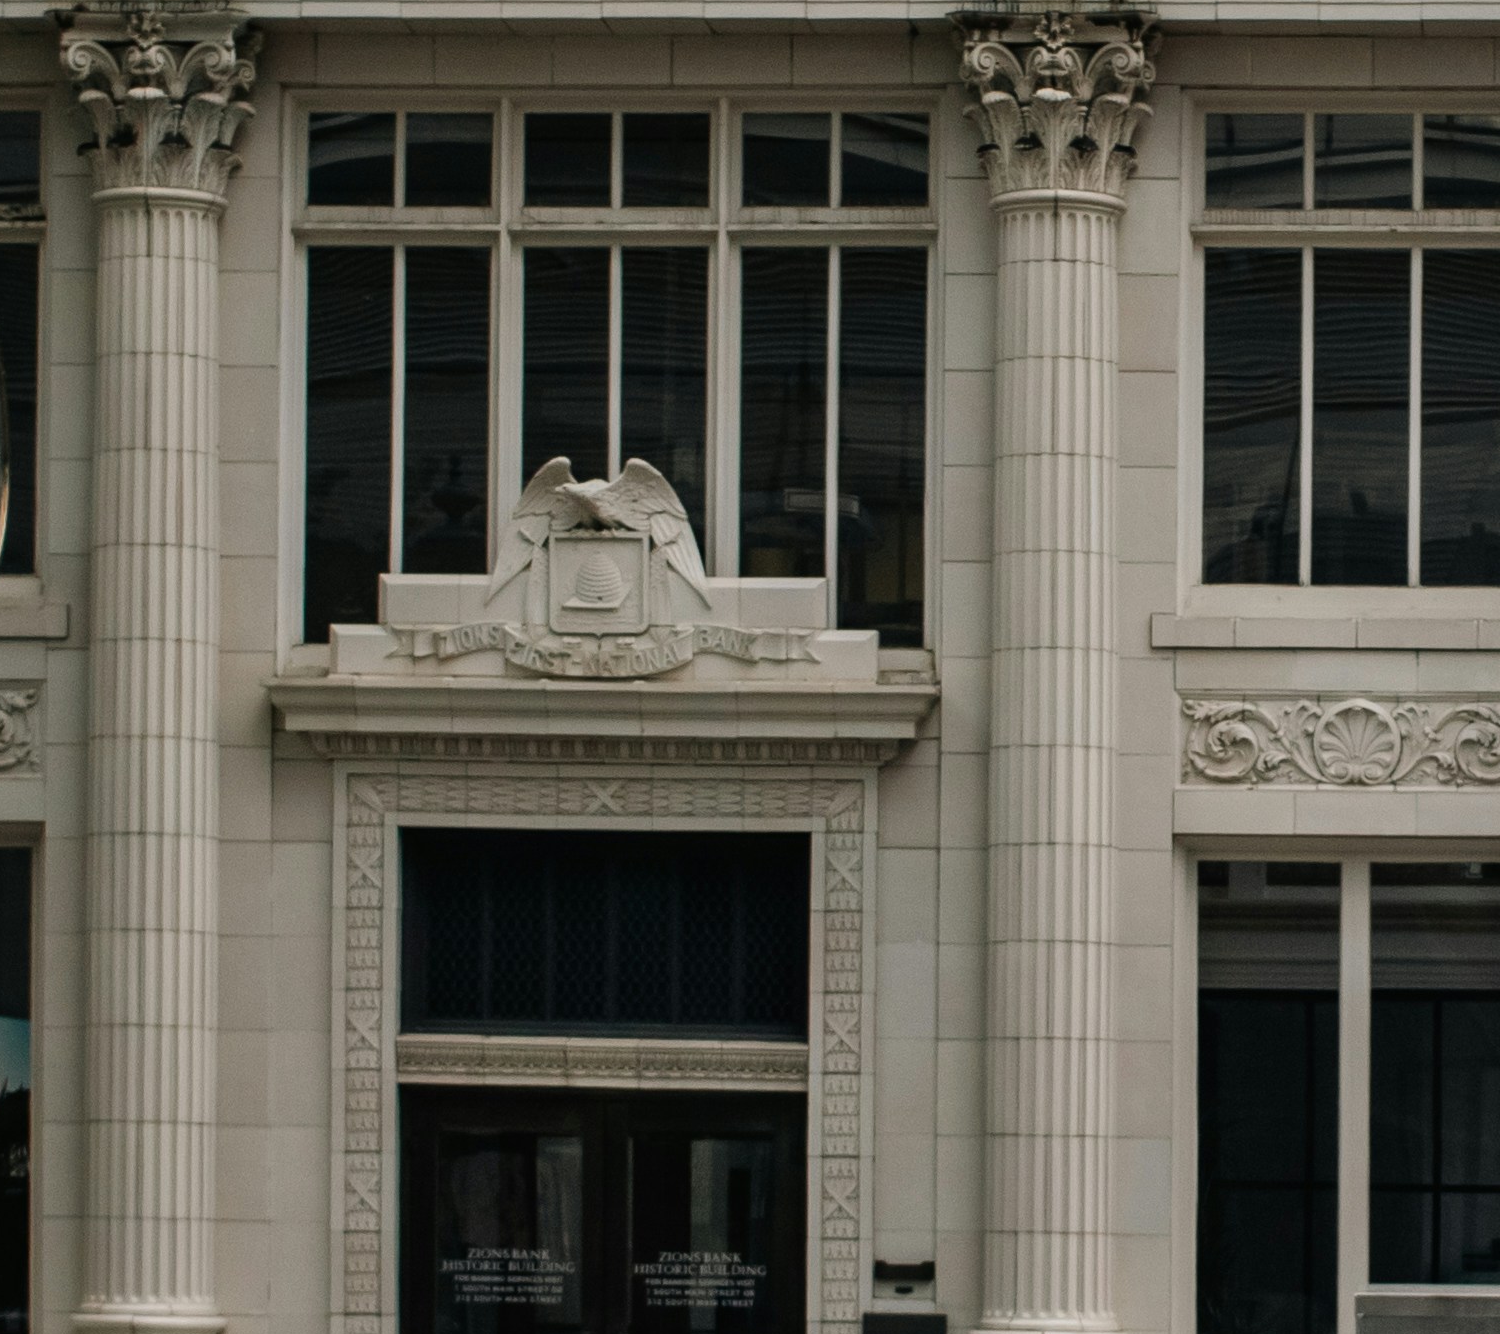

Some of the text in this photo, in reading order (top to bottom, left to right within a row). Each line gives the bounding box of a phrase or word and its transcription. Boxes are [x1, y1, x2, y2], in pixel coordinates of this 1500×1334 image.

[438, 624, 502, 657] ZIONS
[698, 628, 758, 658] BANK
[467, 1248, 550, 1260] ZIONS BANK
[660, 1252, 742, 1263] ZIONS BANK
[441, 1260, 575, 1273] HISTORIC BUILDING
[633, 1264, 767, 1276] HISTORIC BUILDING
